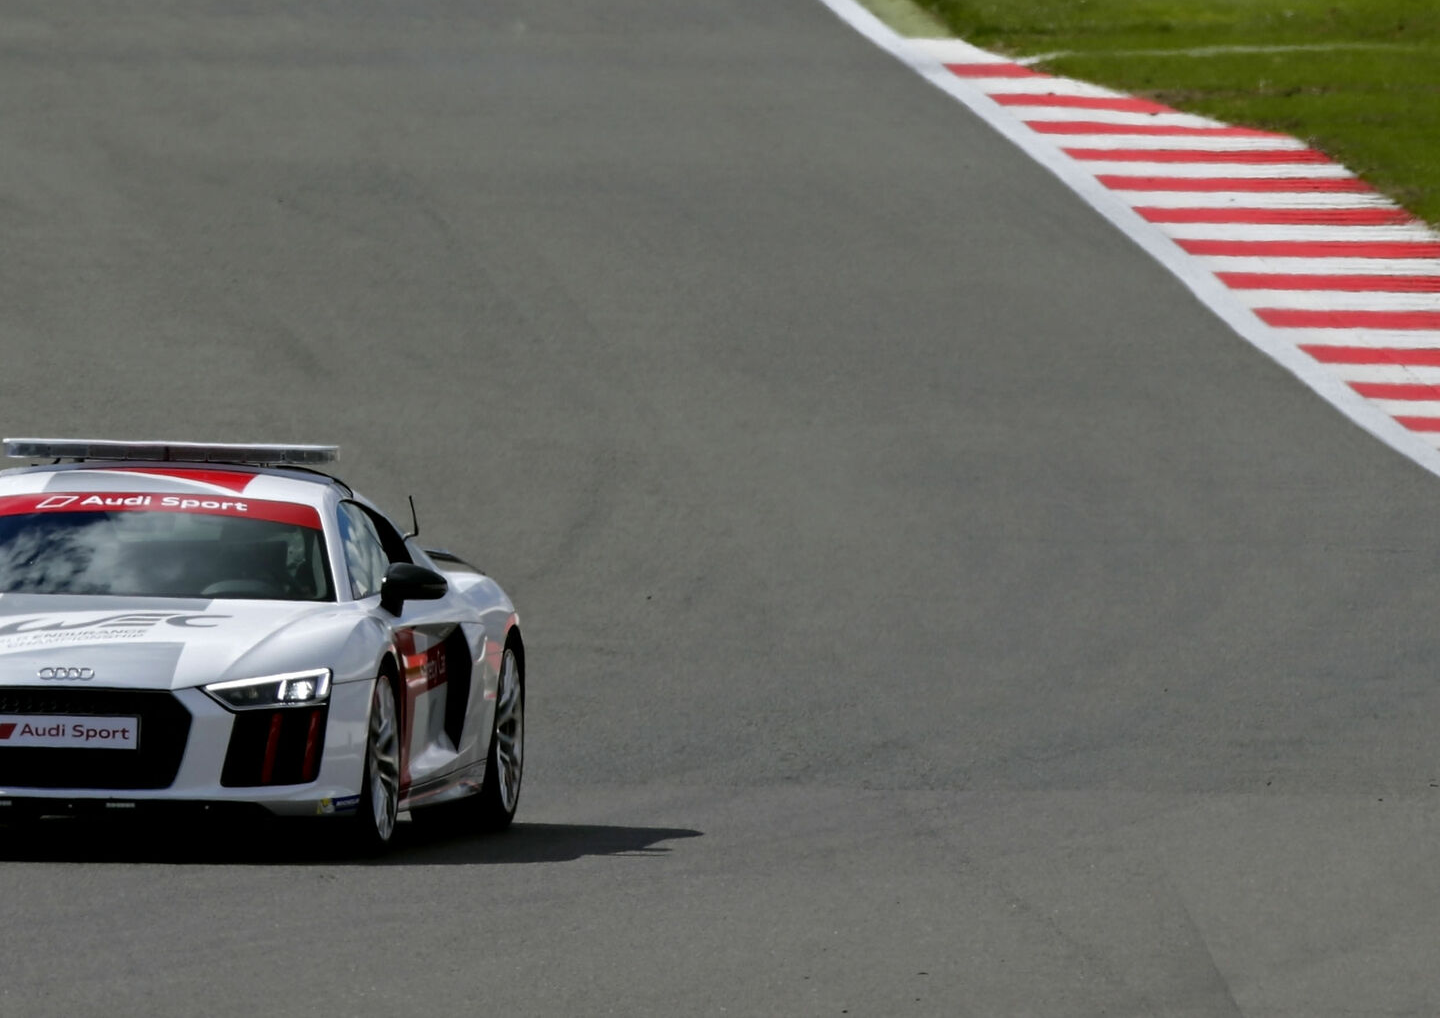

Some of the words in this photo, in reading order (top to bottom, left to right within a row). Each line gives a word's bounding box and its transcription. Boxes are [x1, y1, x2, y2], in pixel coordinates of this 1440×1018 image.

[80, 495, 152, 507] Audi
[160, 496, 248, 512] Sport
[31, 628, 150, 641] ENDURANCE
[19, 723, 66, 738] Audi
[71, 724, 130, 741] Sport
